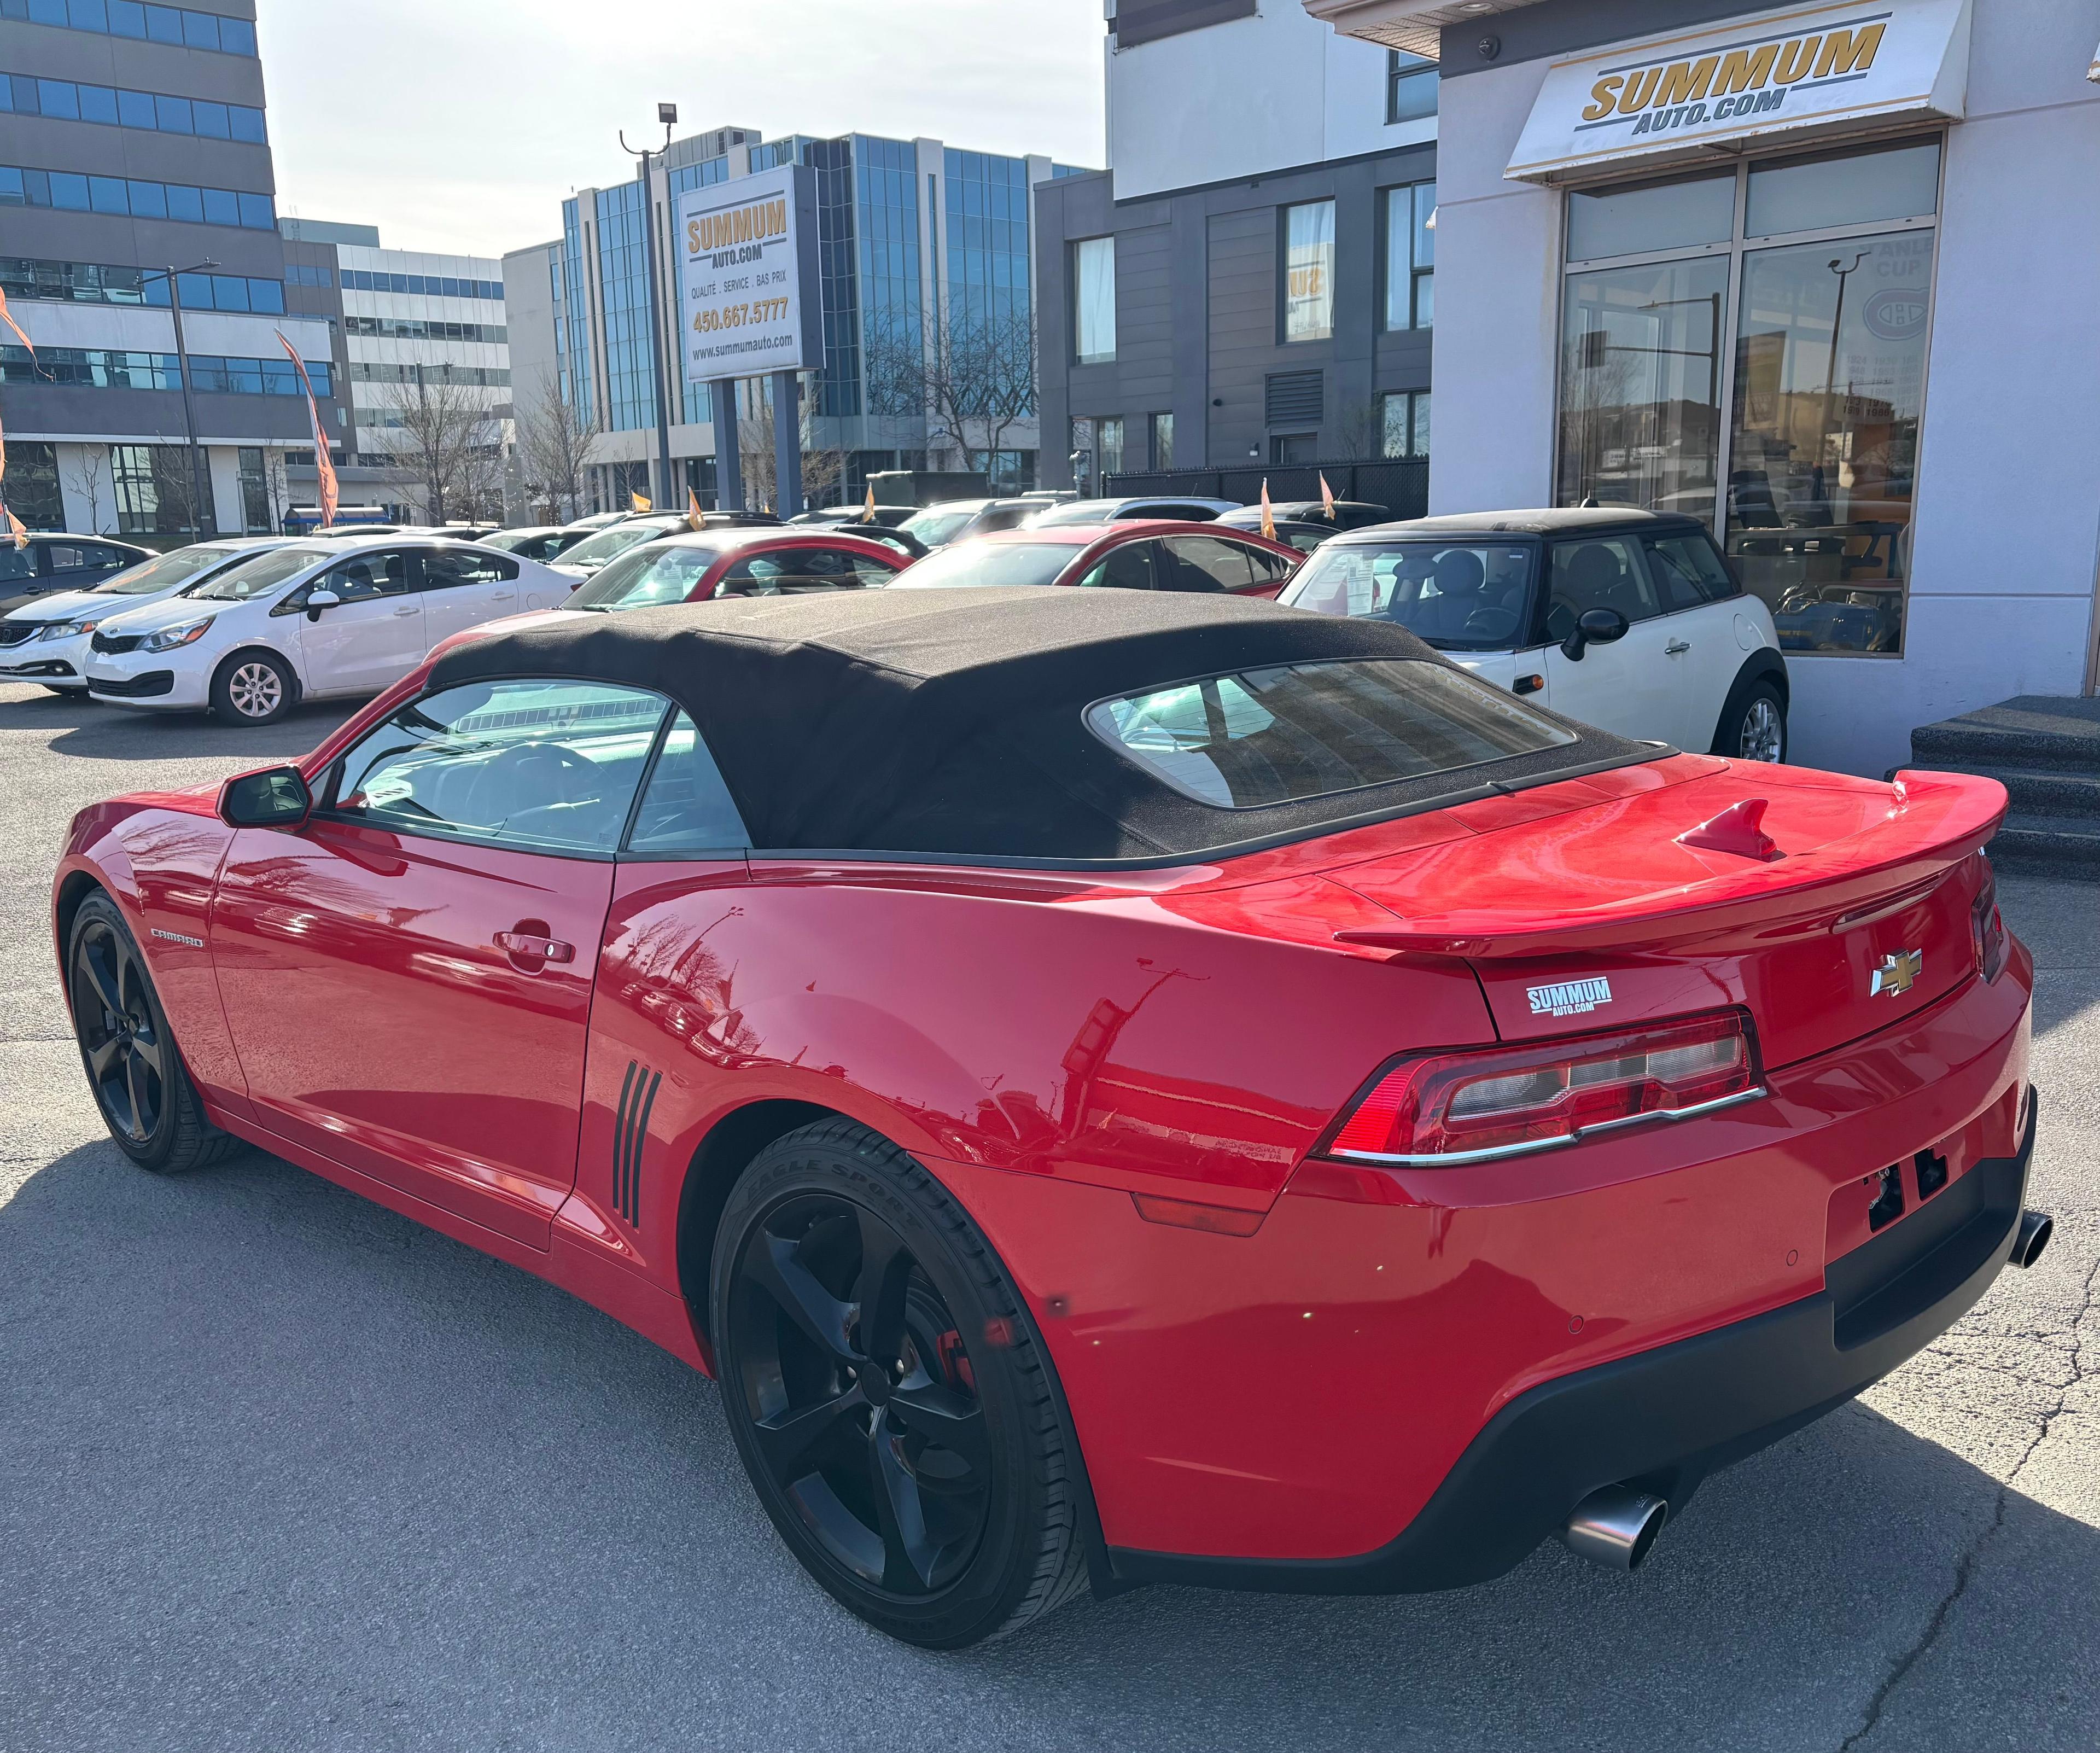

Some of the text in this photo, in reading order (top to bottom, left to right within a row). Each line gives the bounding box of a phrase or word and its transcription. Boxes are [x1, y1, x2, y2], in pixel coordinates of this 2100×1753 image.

[1581, 23, 1887, 121] SUMMUM
[1631, 89, 1786, 135] AUTO.COM
[687, 199, 786, 253] SUMMUM
[712, 243, 762, 269] AUTO.COM
[691, 281, 716, 299] QUALITÉ
[724, 277, 749, 293] SERVICE
[756, 273, 769, 287] BAS
[772, 269, 786, 284] PRIX
[693, 297, 788, 333] 450.667.5777
[693, 334, 792, 361] www.summumauto.com
[151, 928, 203, 947] CAMARO
[1527, 980, 1612, 1010] SUMMUM
[1553, 1001, 1595, 1017] AUTO.COM
[746, 1160, 822, 1201] EAGLE
[831, 1163, 924, 1230] SPORT
